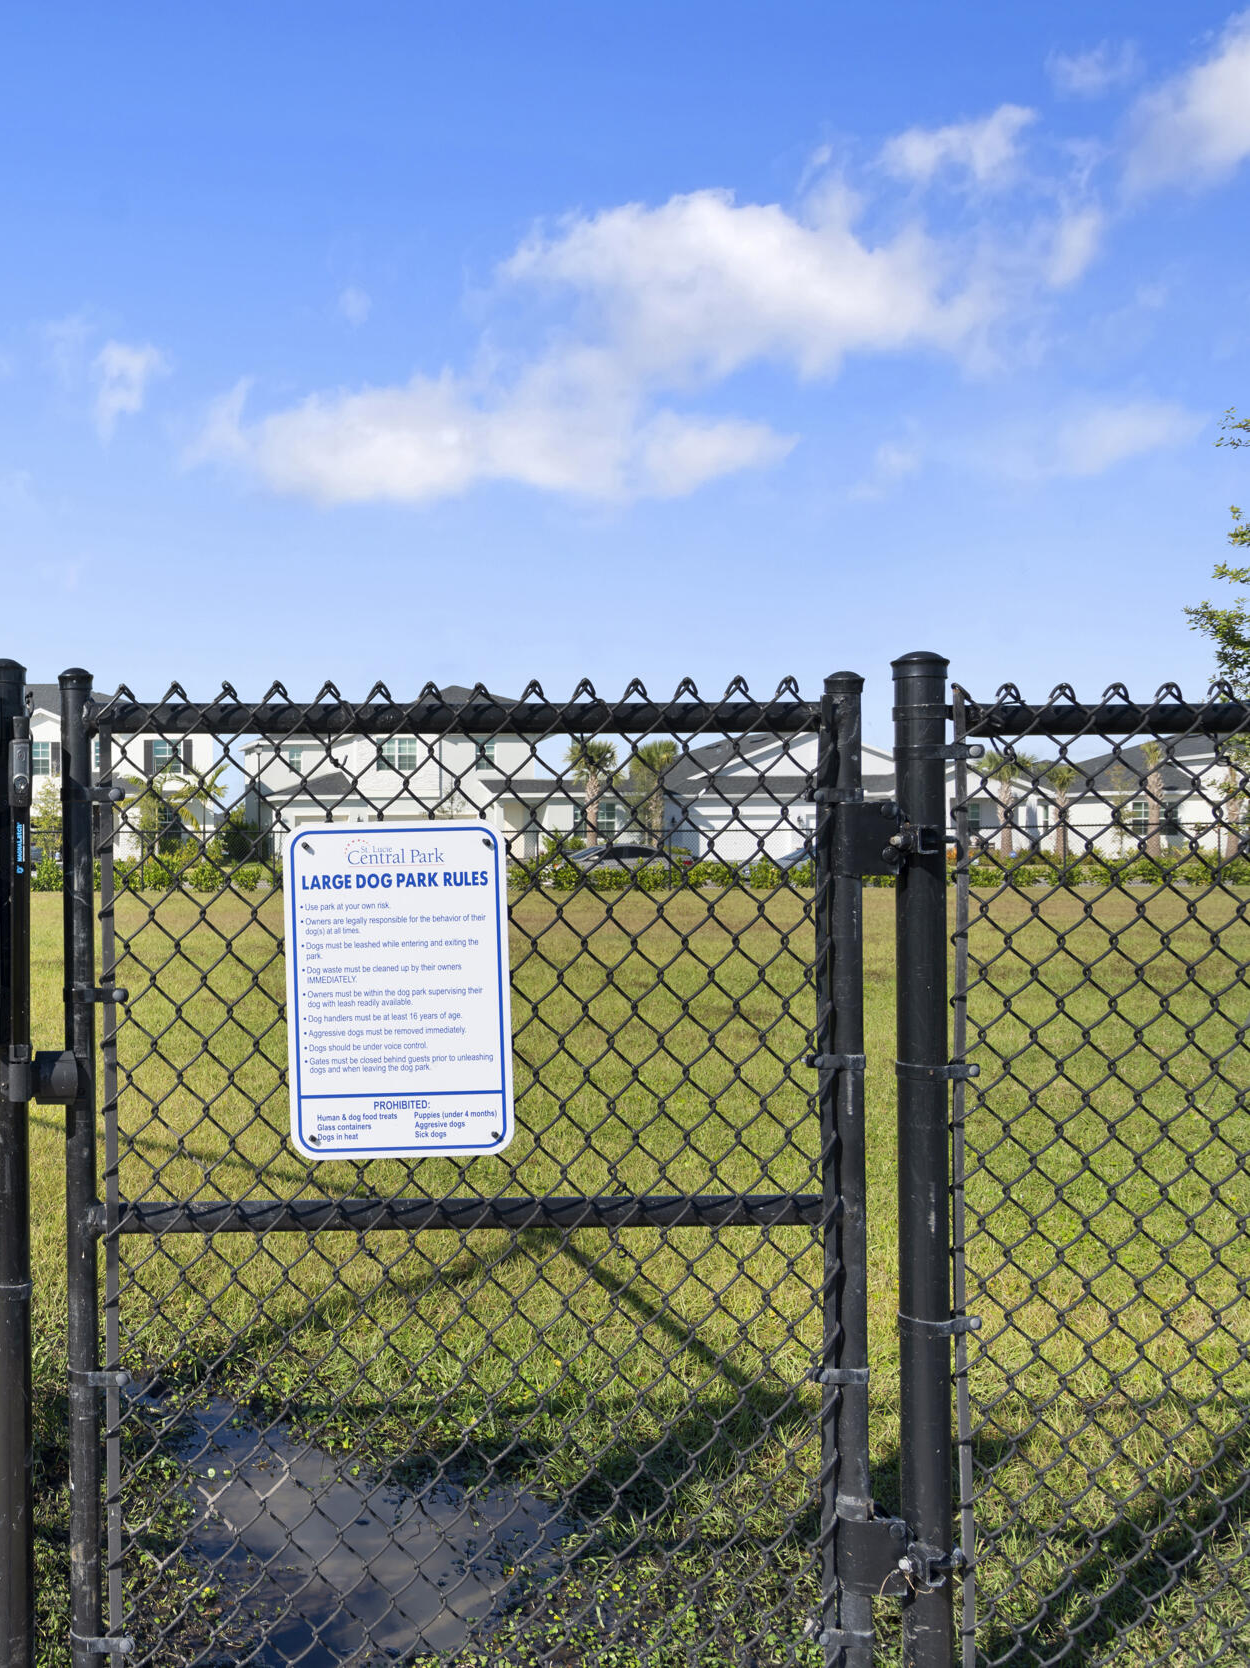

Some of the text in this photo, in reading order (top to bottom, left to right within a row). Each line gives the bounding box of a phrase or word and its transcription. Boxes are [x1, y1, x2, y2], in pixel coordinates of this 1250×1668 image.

[347, 847, 445, 865] Central Park
[302, 871, 488, 890] LARGE DOG PARK RULES
[304, 903, 318, 911] Use
[320, 903, 335, 911] park
[345, 903, 360, 911] your
[305, 927, 325, 936] dog(s)
[326, 927, 333, 935] at
[306, 938, 479, 951] Dogs must be leashed while entering and exiting the
[307, 990, 334, 999] Owners
[335, 990, 352, 998] must
[363, 989, 383, 997] within
[397, 988, 410, 998] dog
[411, 988, 427, 997] park
[428, 987, 466, 997] supervising
[307, 1000, 321, 1009] dog
[337, 999, 356, 1007] leash
[357, 998, 380, 1008] readily
[308, 1029, 346, 1038] Aggressive
[347, 1028, 364, 1037] dogs
[366, 1028, 383, 1036] must
[384, 1027, 393, 1035] be
[394, 1027, 424, 1035] removed
[309, 1053, 494, 1066] Gates must be closed behind guests prior to unleashing
[373, 1099, 430, 1110] PROHIBITED:
[317, 1114, 340, 1122] Human
[341, 1113, 347, 1121] &
[348, 1113, 361, 1122] dog
[414, 1111, 441, 1120] Puppies
[442, 1111, 463, 1119] (under
[470, 1110, 497, 1119] months)
[317, 1122, 372, 1131] Glass containers
[415, 1120, 466, 1130] Aggresive dogs
[317, 1133, 335, 1142] Dogs
[430, 1130, 447, 1139] dogs
